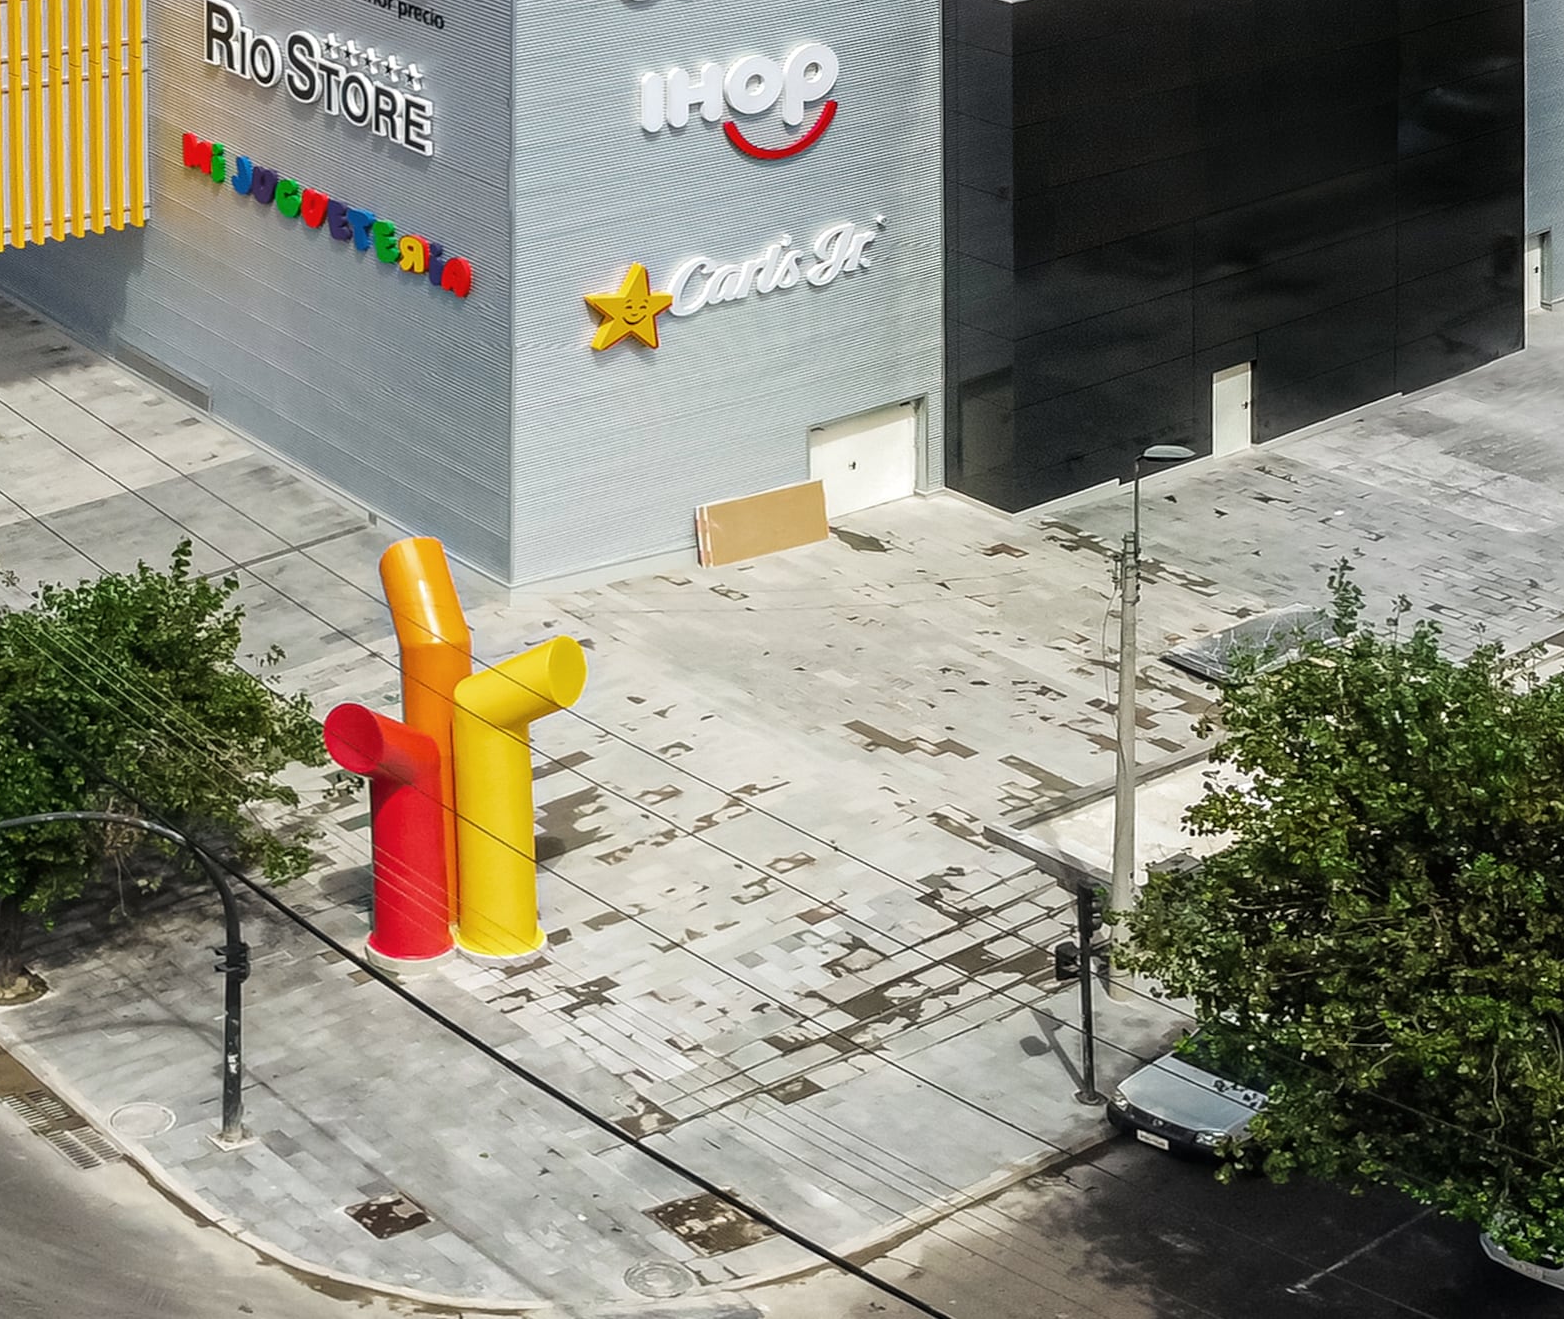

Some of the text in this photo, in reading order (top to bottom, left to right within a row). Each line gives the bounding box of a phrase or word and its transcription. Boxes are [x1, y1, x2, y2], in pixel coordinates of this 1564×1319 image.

[397, 1, 445, 30] precio
[285, 31, 434, 156] STORE
[640, 42, 839, 133] IHOP
[666, 233, 804, 317] Carl's
